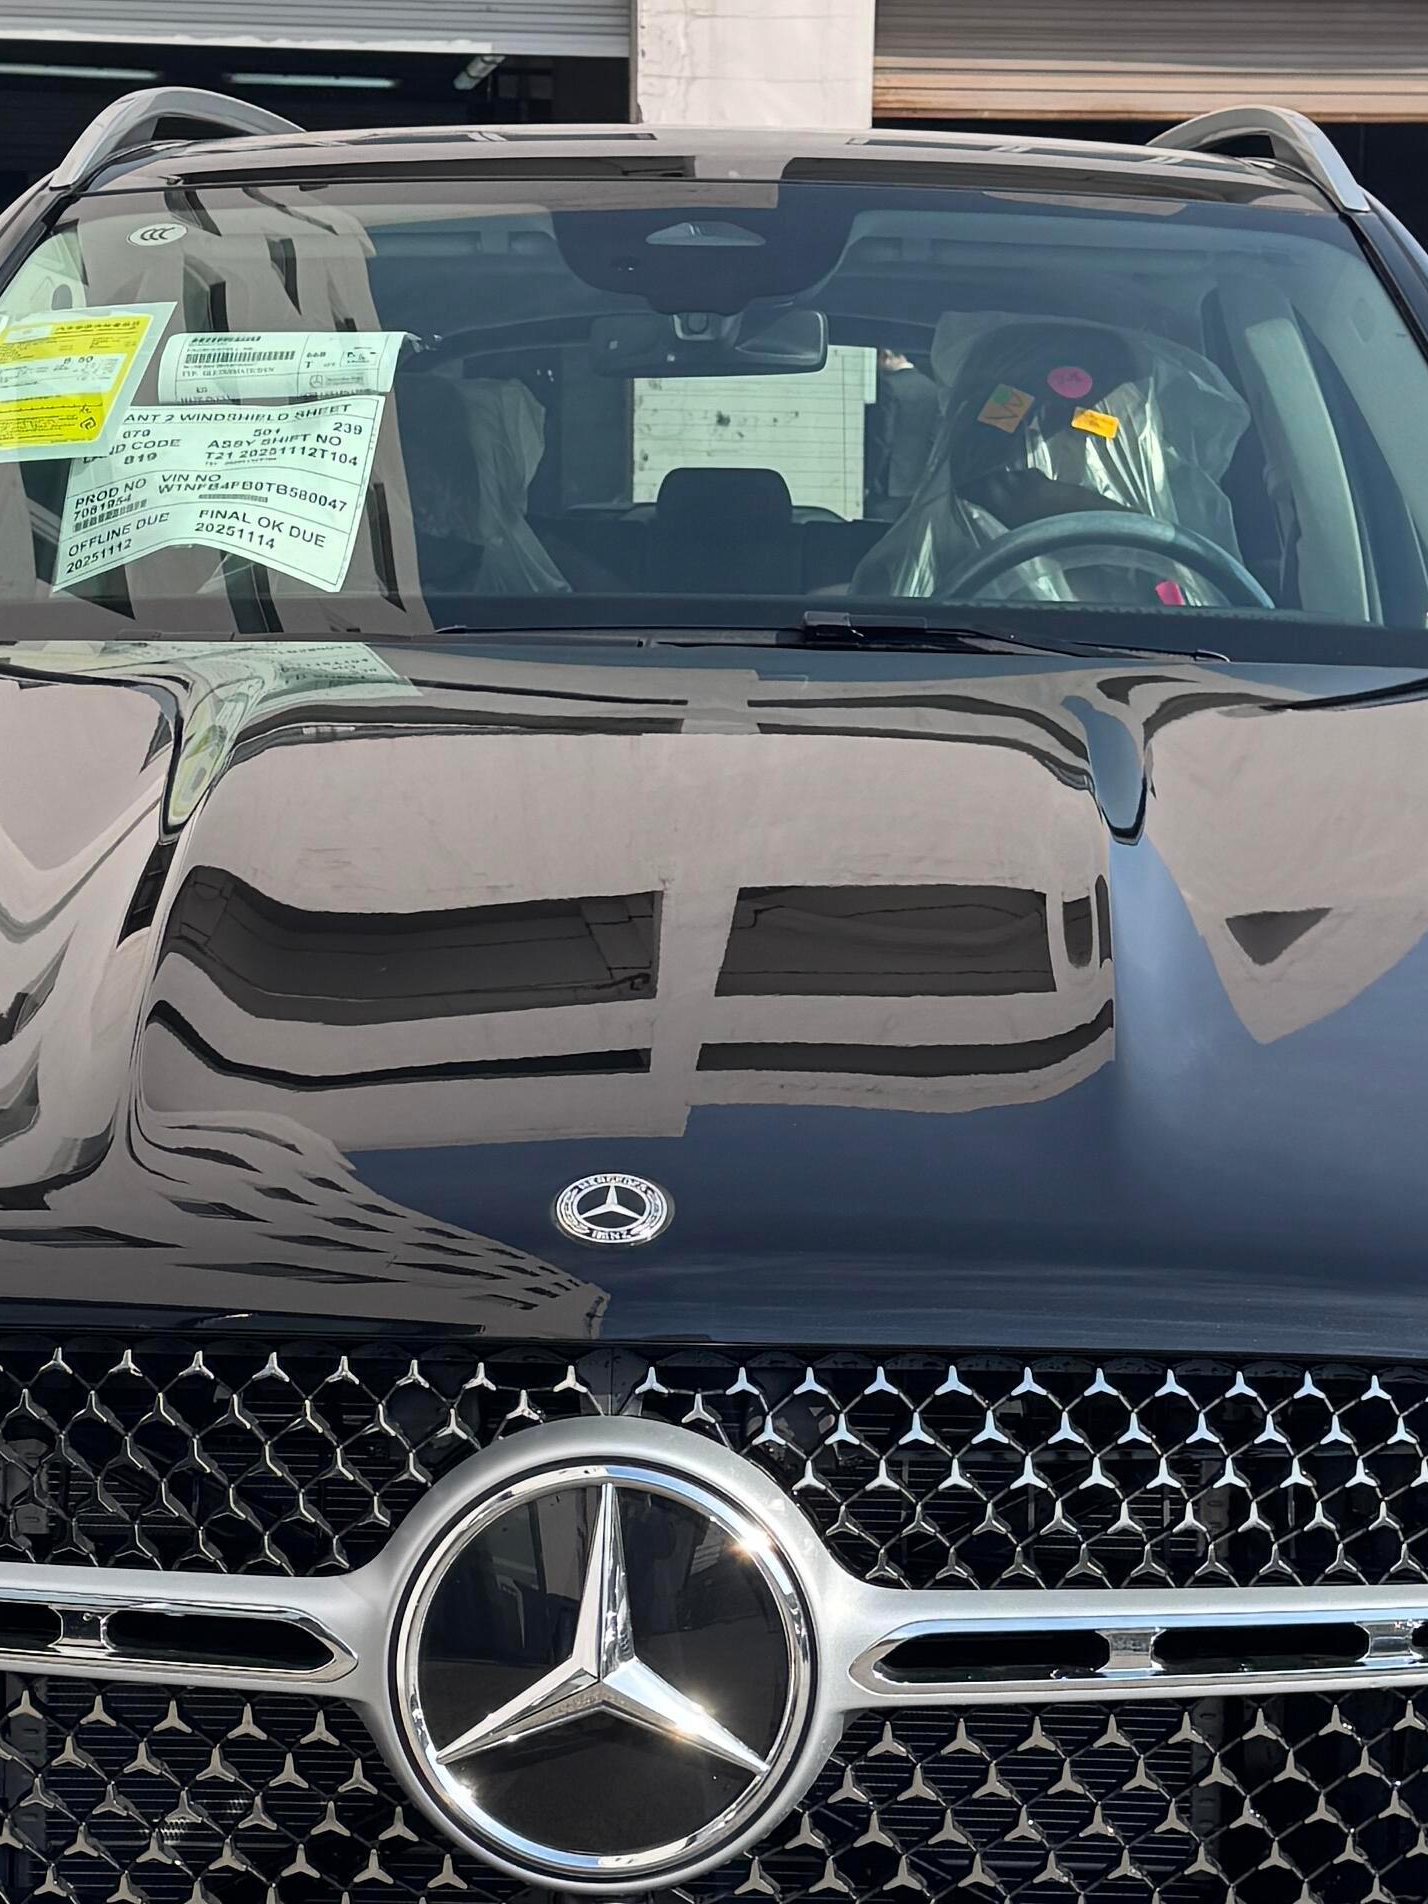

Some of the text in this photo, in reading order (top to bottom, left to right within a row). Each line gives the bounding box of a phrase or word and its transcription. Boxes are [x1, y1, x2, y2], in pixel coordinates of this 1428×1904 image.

[124, 413, 161, 423] ANT
[333, 421, 362, 435] 239
[131, 439, 181, 450] CODE
[316, 433, 342, 446] NO
[161, 474, 222, 482] VIN NO
[75, 478, 147, 509] PROD NO
[68, 512, 170, 557] OFFLINE DUE
[194, 522, 275, 549] 20251114
[199, 509, 326, 548] FINAL OK DUE
[66, 538, 132, 574] 20251112
